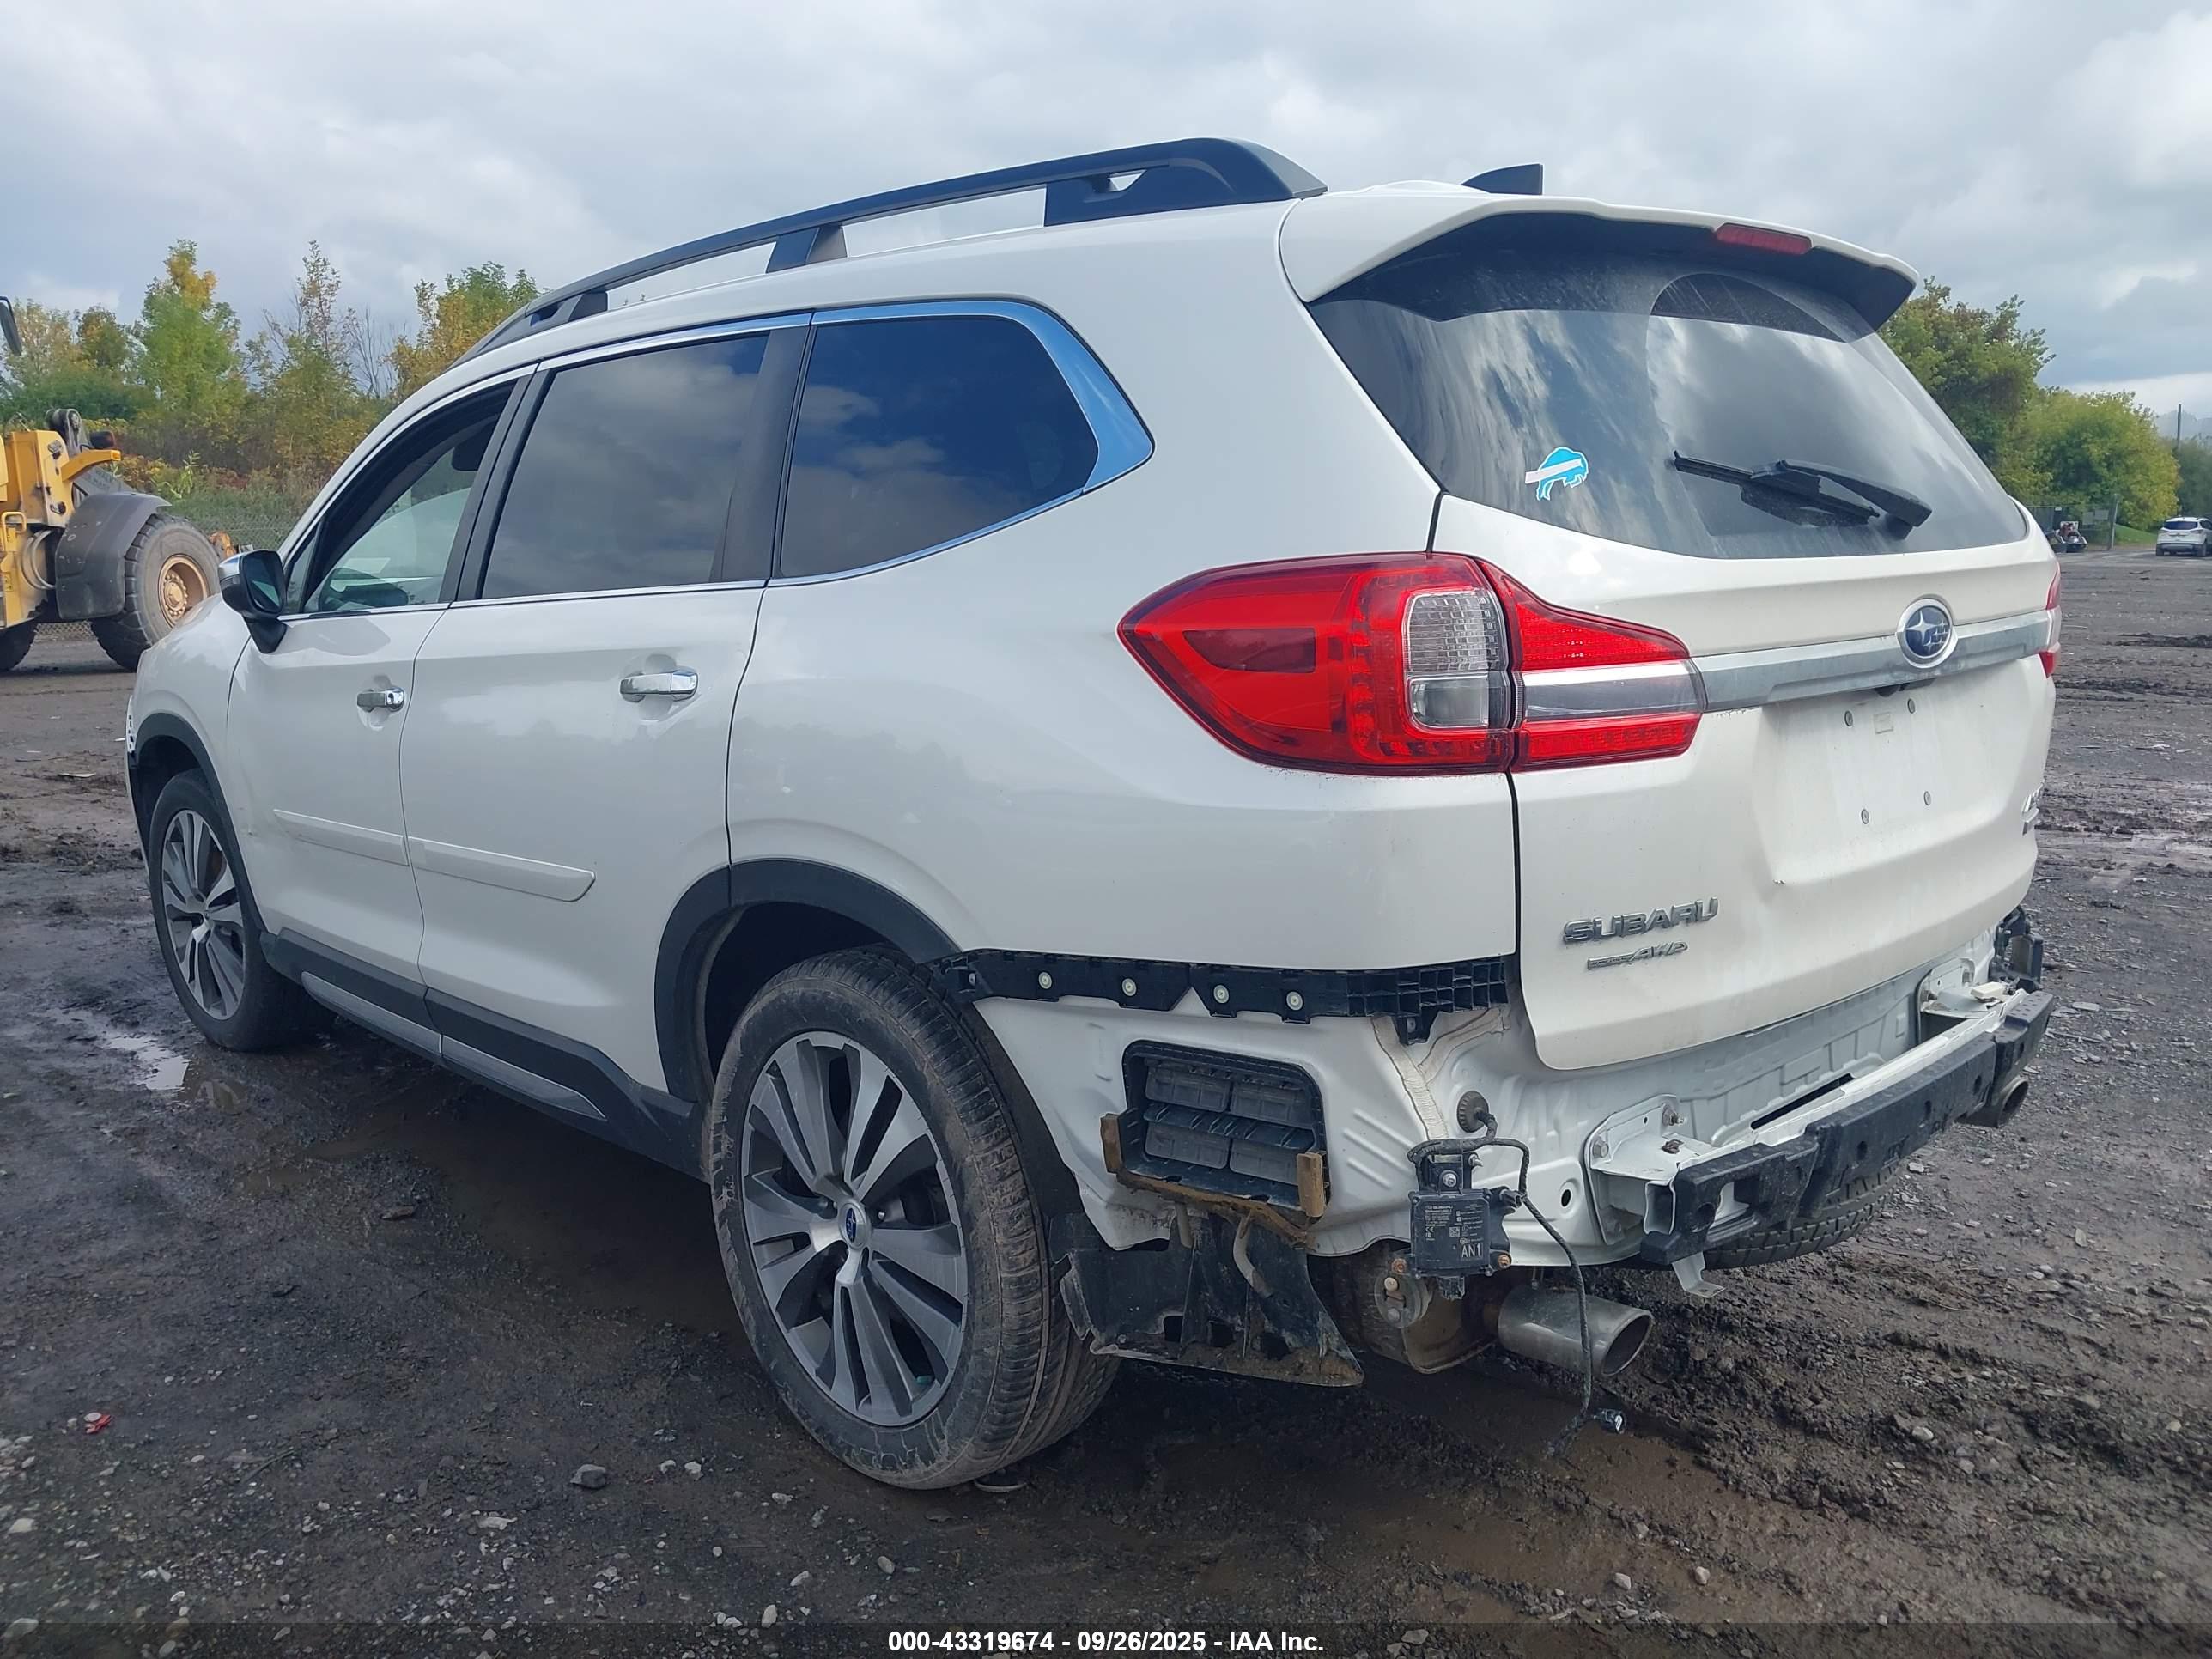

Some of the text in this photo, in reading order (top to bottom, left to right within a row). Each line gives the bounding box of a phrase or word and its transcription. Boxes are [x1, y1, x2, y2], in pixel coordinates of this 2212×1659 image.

[1563, 896, 1719, 942] SUBARU
[1630, 941, 1688, 961] AWD
[1462, 1243, 1480, 1258] AN1
